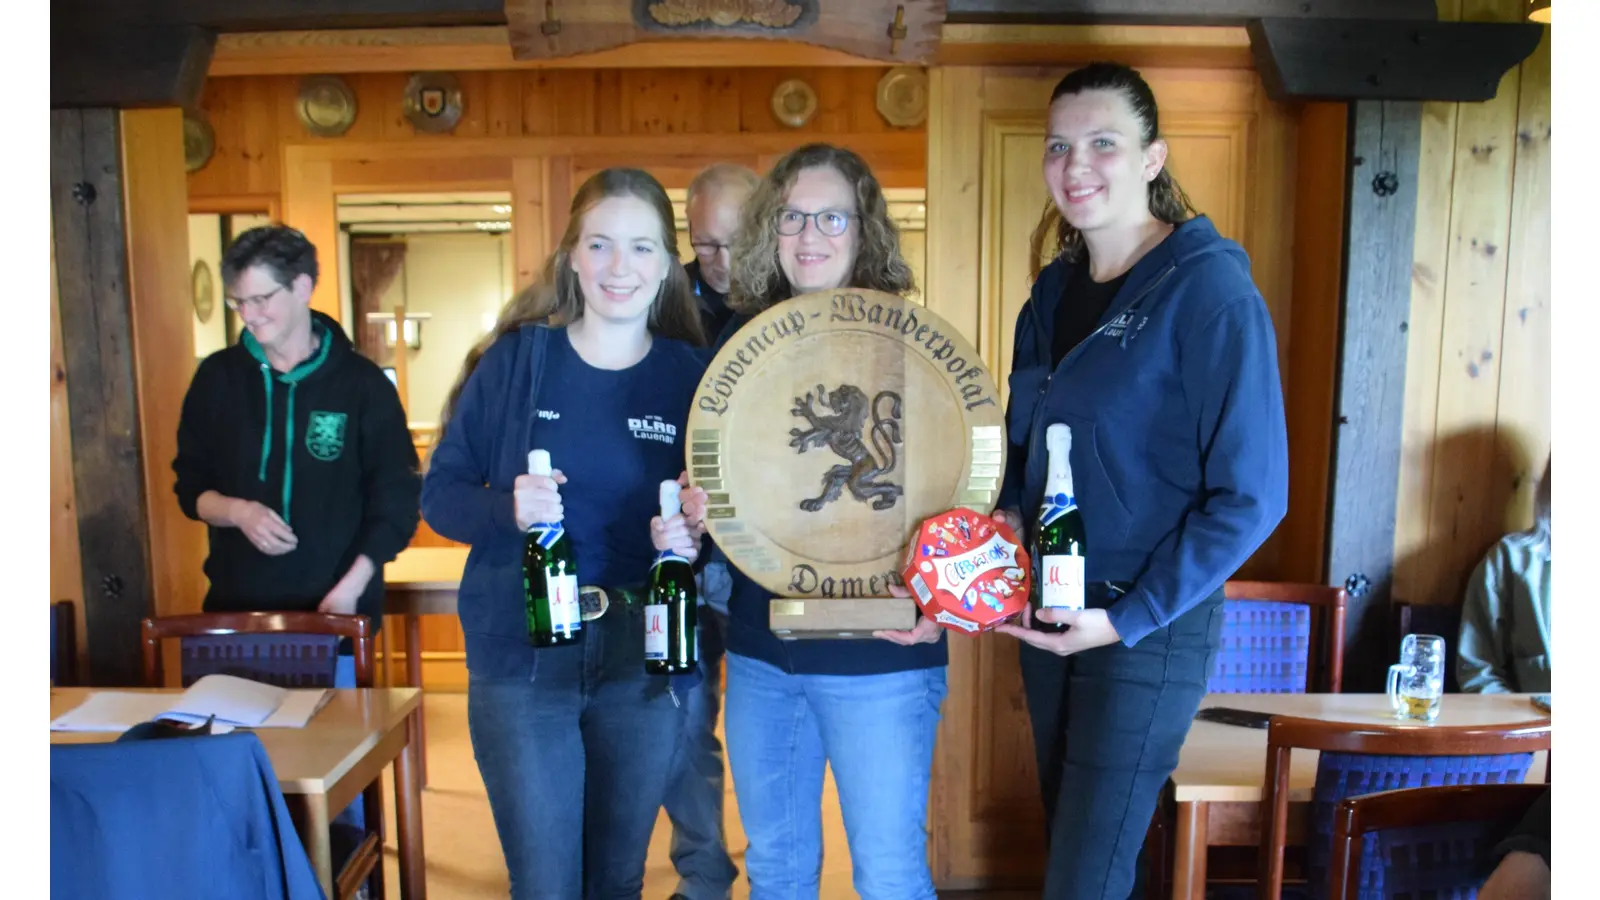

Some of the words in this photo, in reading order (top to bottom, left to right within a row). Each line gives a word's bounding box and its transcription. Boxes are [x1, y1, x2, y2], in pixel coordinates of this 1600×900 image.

[699, 309, 805, 417] Löwencup
[830, 293, 996, 412] Wanderpokal
[628, 418, 677, 436] DLRG
[788, 563, 901, 598] Damen
